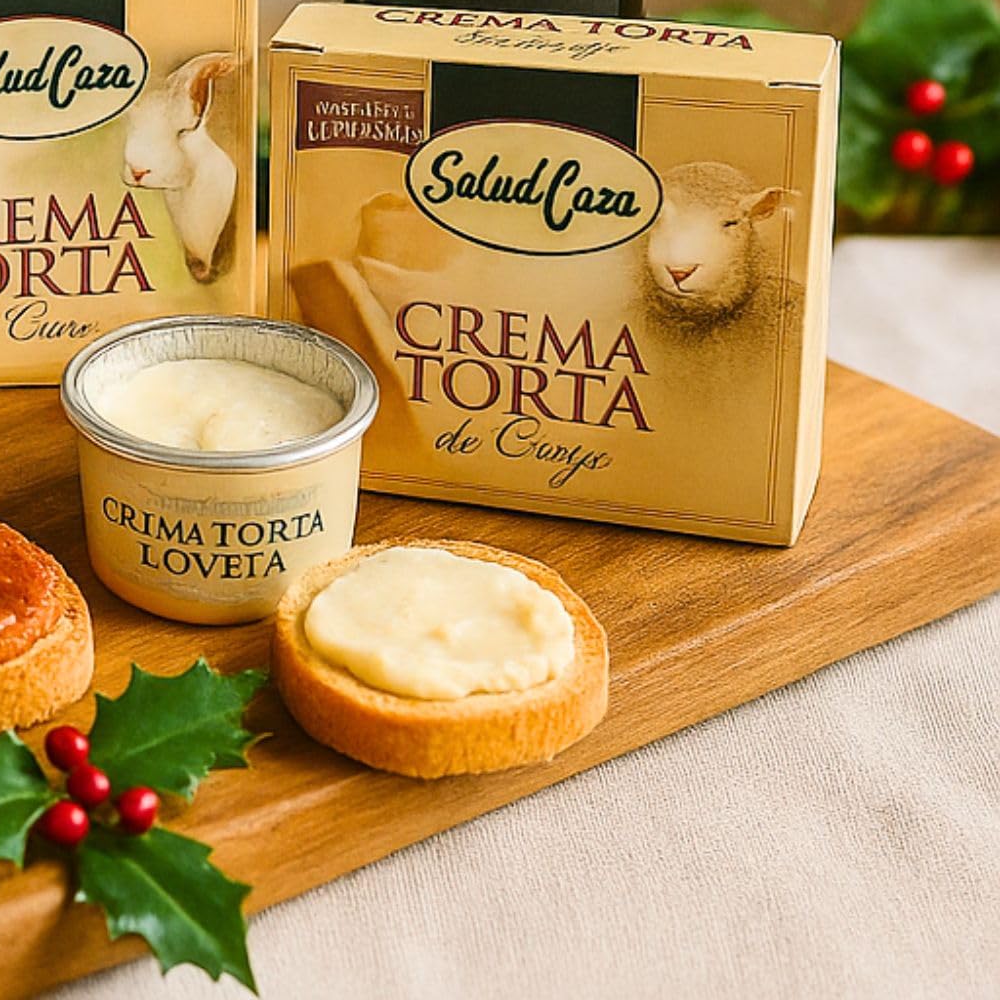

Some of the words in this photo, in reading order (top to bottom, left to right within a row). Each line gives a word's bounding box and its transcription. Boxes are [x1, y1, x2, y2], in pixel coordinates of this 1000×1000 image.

[375, 8, 562, 33] CREMA
[580, 20, 753, 51] TORTA
[395, 301, 651, 377] CREMA
[395, 351, 654, 433] TORTA
[435, 418, 482, 453] de
[102, 496, 205, 547] CRIMA
[211, 509, 324, 547] TORTA
